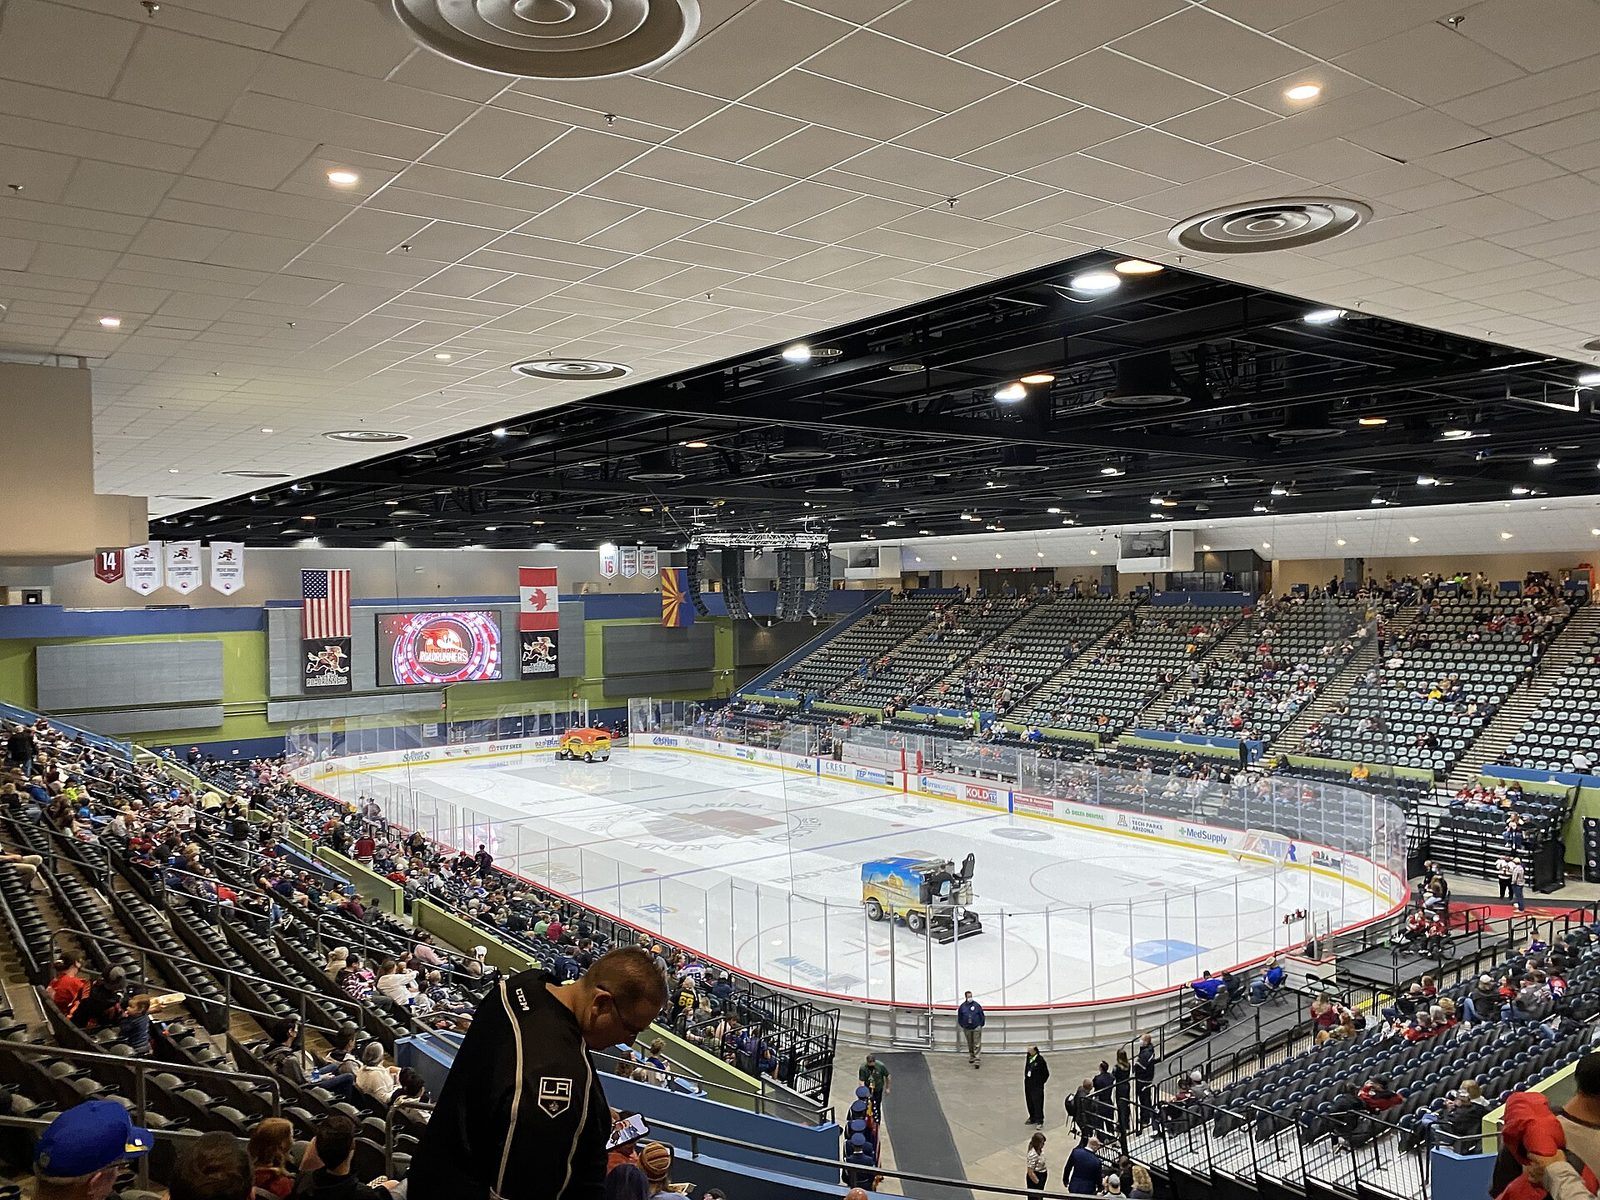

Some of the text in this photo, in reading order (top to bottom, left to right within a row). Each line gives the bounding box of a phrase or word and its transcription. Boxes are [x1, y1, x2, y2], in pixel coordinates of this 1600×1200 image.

[102, 552, 116, 570] 14
[605, 560, 614, 573] 16
[418, 651, 469, 663] ROADRUNNERS
[825, 762, 847, 772] CREST
[966, 787, 989, 799] KOLD
[1132, 826, 1155, 834] ARIZONA
[1146, 822, 1163, 831] PARKS
[1187, 828, 1228, 844] MedSupply
[515, 987, 530, 1011] CCM
[679, 995, 694, 1008] 68
[543, 1081, 569, 1096] LA
